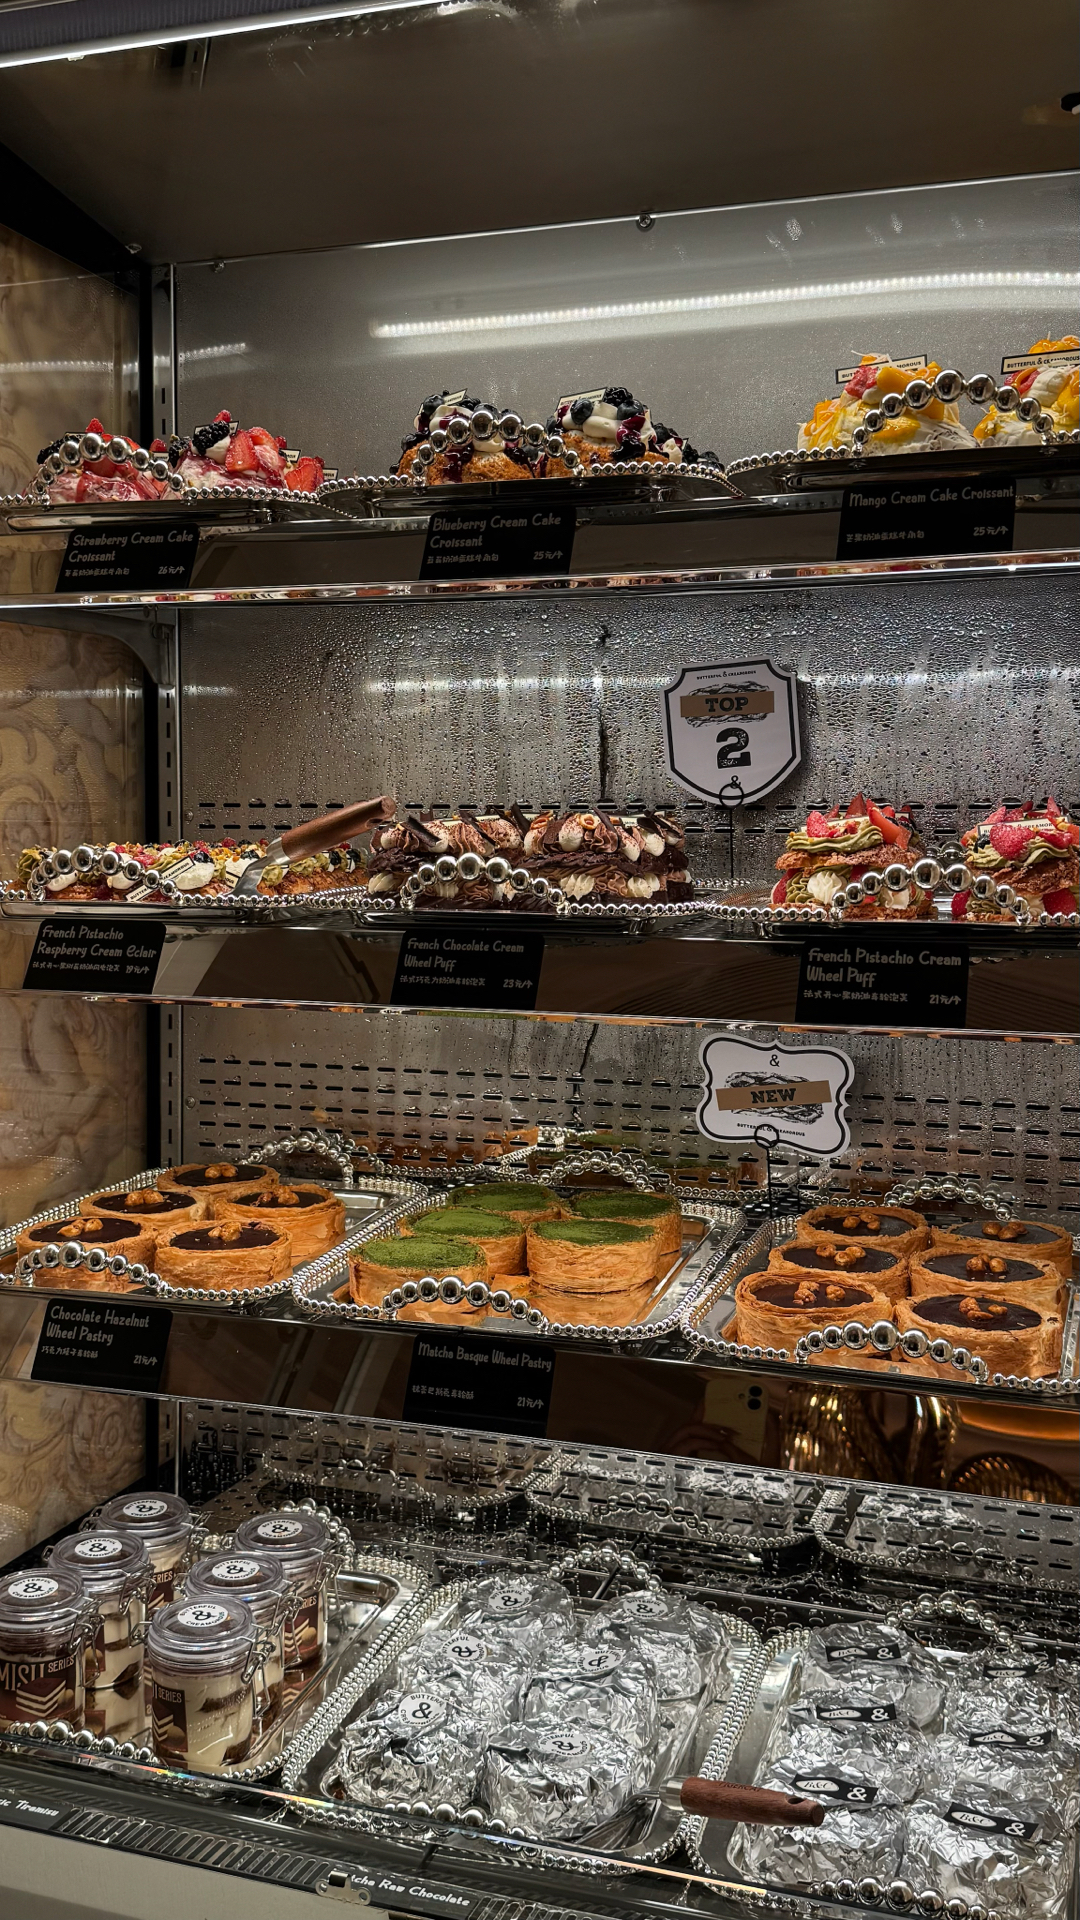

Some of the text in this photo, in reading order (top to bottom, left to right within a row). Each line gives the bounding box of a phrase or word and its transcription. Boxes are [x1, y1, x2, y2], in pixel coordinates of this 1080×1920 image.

[849, 485, 1014, 508] Mango Cream Cake Croissant
[432, 512, 562, 532] Blueberry Cream Cake
[73, 530, 194, 547] Strawberry Cream Cake
[430, 535, 483, 549] Croissant
[68, 550, 116, 563] Croissant
[705, 697, 749, 713] TOP
[716, 727, 752, 769] 2
[42, 925, 124, 940] French Pistachio
[36, 940, 88, 959] Raspberry
[90, 943, 123, 957] Cream
[407, 937, 525, 953] French Chocolate Cream
[403, 953, 457, 973] Wheel Puff
[808, 947, 962, 966] French Pistachio Cream
[806, 964, 878, 988] Wheel Puff
[769, 1054, 780, 1067] &
[750, 1087, 797, 1104] NEW
[50, 1305, 150, 1328] Chocolate Hazelnut
[46, 1321, 114, 1346] Wheel Pastry
[418, 1341, 553, 1373] Matcha Basque Wheel Pastry
[136, 1504, 158, 1513] &
[271, 1524, 291, 1533] &
[89, 1542, 109, 1552] &
[226, 1564, 248, 1574] &
[152, 1571, 173, 1583] ERIES
[22, 1582, 46, 1593] &
[501, 1595, 523, 1607] &
[636, 1603, 656, 1614] &
[191, 1610, 218, 1621] &
[451, 1645, 478, 1658] &
[876, 1647, 894, 1659] &
[47, 1655, 75, 1673] SERIES
[1035, 1661, 1053, 1673] &
[158, 1687, 182, 1704] SERIES
[411, 1702, 433, 1719] &
[871, 1708, 890, 1721] &
[552, 1740, 581, 1751] &
[1026, 1736, 1045, 1747] &
[847, 1787, 868, 1801] &
[15, 1799, 60, 1817] Tiramisu
[1004, 1822, 1026, 1837] &
[351, 1874, 470, 1906] tcha Raw Chocolate
